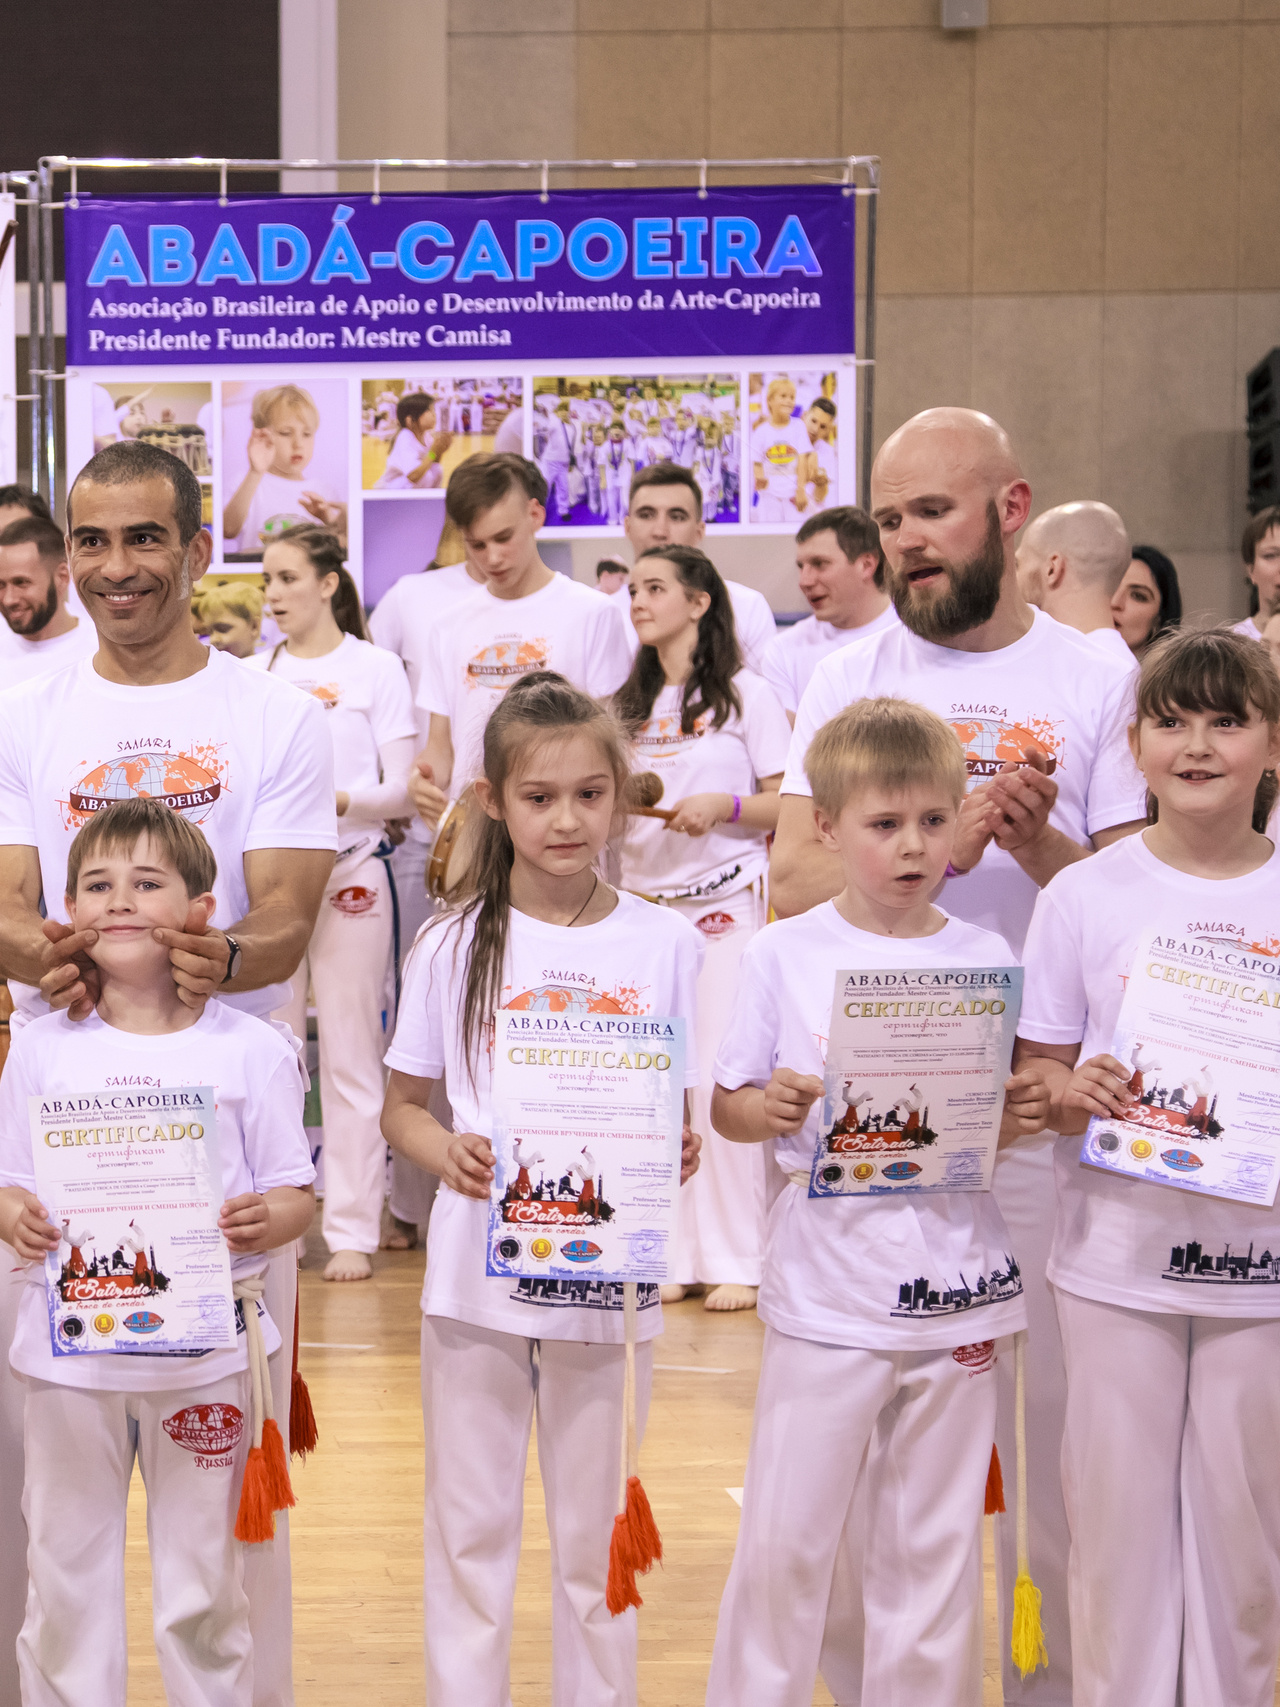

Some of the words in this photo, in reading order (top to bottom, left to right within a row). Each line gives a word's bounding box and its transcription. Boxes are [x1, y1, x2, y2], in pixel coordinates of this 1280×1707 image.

[86, 203, 823, 287] ABADÁ-CAPOEIRA
[88, 297, 208, 322] Associação
[213, 295, 315, 317] Brasileira
[321, 294, 348, 316] de
[353, 293, 420, 321] Apoio
[424, 299, 438, 314] e
[443, 290, 633, 314] Desenvolvimento
[637, 289, 665, 311] da
[669, 287, 822, 316] Arte-Capoeira
[88, 328, 211, 351] Presidente
[217, 326, 336, 350] Fundador:
[340, 325, 421, 349] Mestre
[425, 324, 512, 347] Camisa
[950, 703, 1008, 718] SAMARA
[117, 737, 172, 753] SAMARA
[1186, 921, 1246, 937] SAMARA
[1151, 934, 1280, 976] ABADÁ-CAPO
[542, 969, 596, 986] SAMARA
[844, 972, 1012, 986] ABADÁ-CAPOEIRA
[842, 999, 1006, 1018] CERTIFICADO
[506, 1016, 674, 1036] ABADÁ-CAPOEIRA
[506, 1034, 538, 1042] Presidente
[538, 1035, 569, 1043] Fundador:
[507, 1045, 671, 1072] CERTIFICADO
[105, 1075, 162, 1089] SAMARA
[39, 1092, 203, 1112] ABADÁ-CAPOEIRA
[40, 1116, 72, 1124] Presidente
[72, 1115, 102, 1123] Fundador:
[43, 1121, 205, 1147] CERTIFICADO
[840, 1132, 919, 1152] Batizado
[515, 1200, 595, 1226] Batizado
[73, 1276, 151, 1300] Batizado
[194, 1453, 234, 1471] Russia
